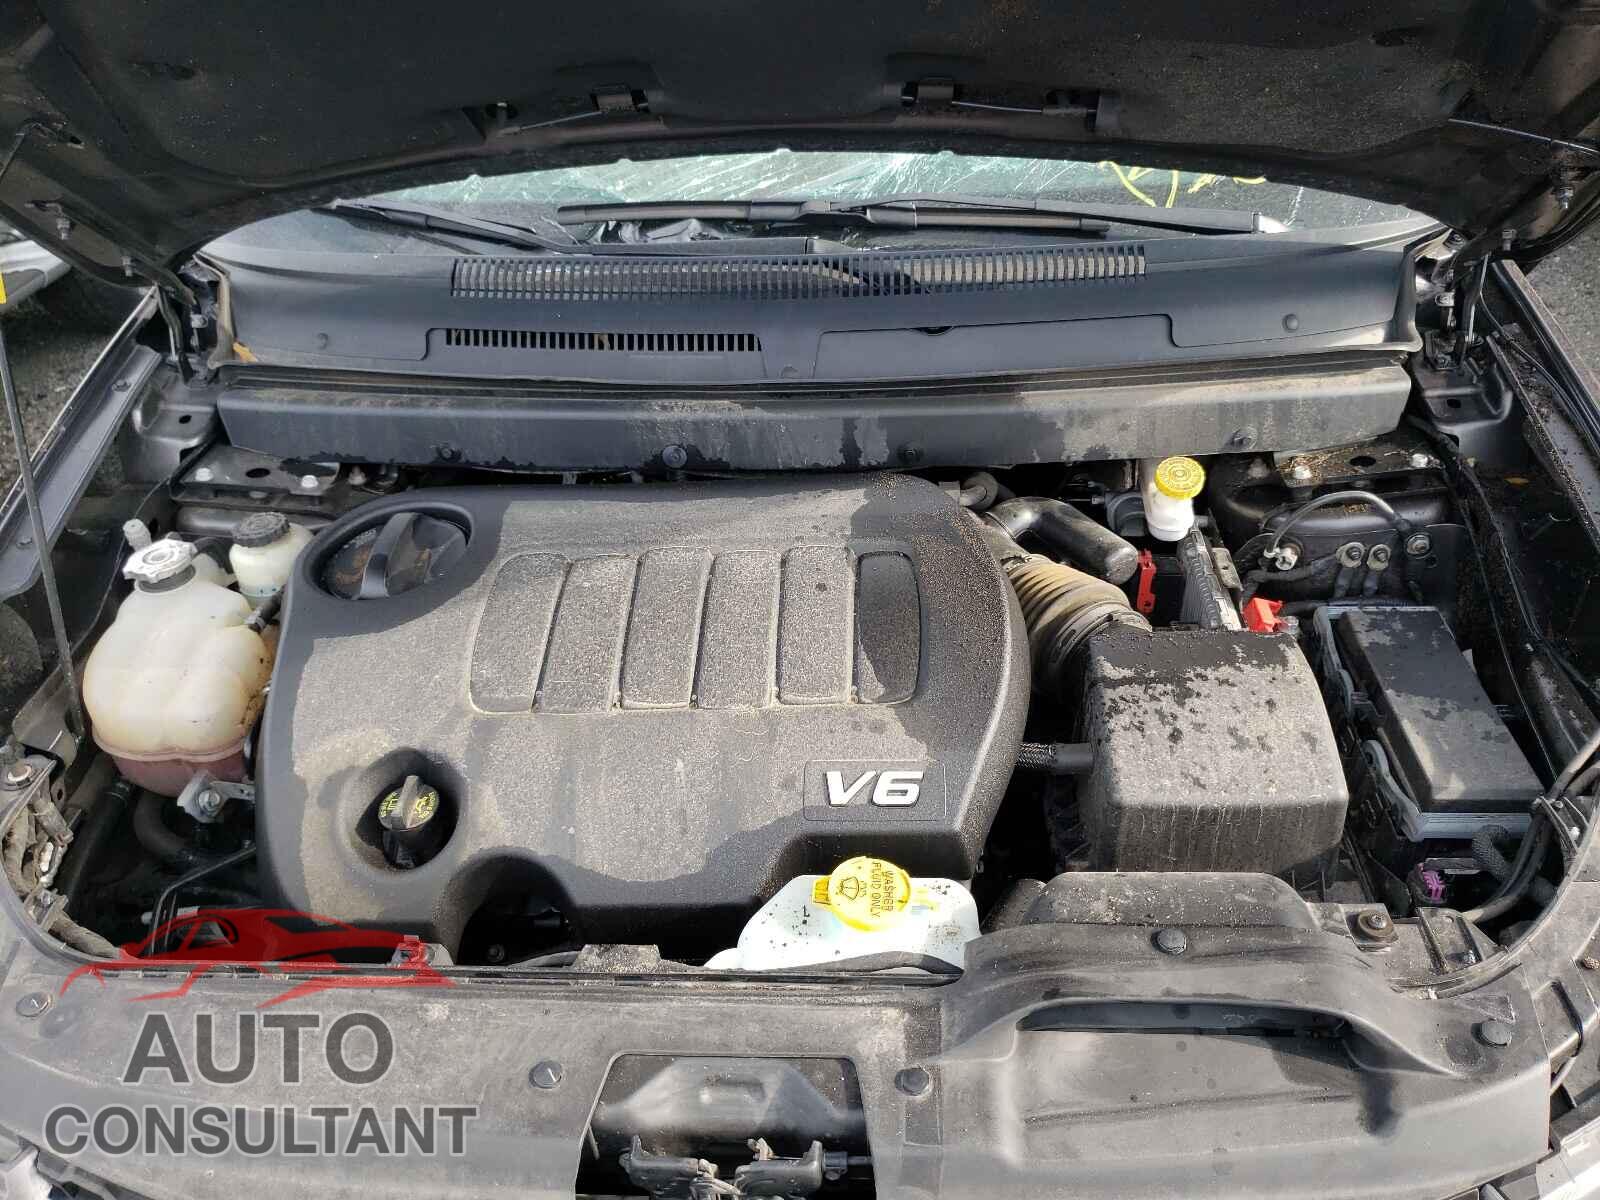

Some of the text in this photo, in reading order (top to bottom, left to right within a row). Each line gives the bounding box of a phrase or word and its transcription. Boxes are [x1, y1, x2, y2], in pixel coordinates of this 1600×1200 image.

[825, 770, 925, 807] V6
[870, 862, 882, 918] FLUID ONLY
[881, 870, 895, 912] WASHER
